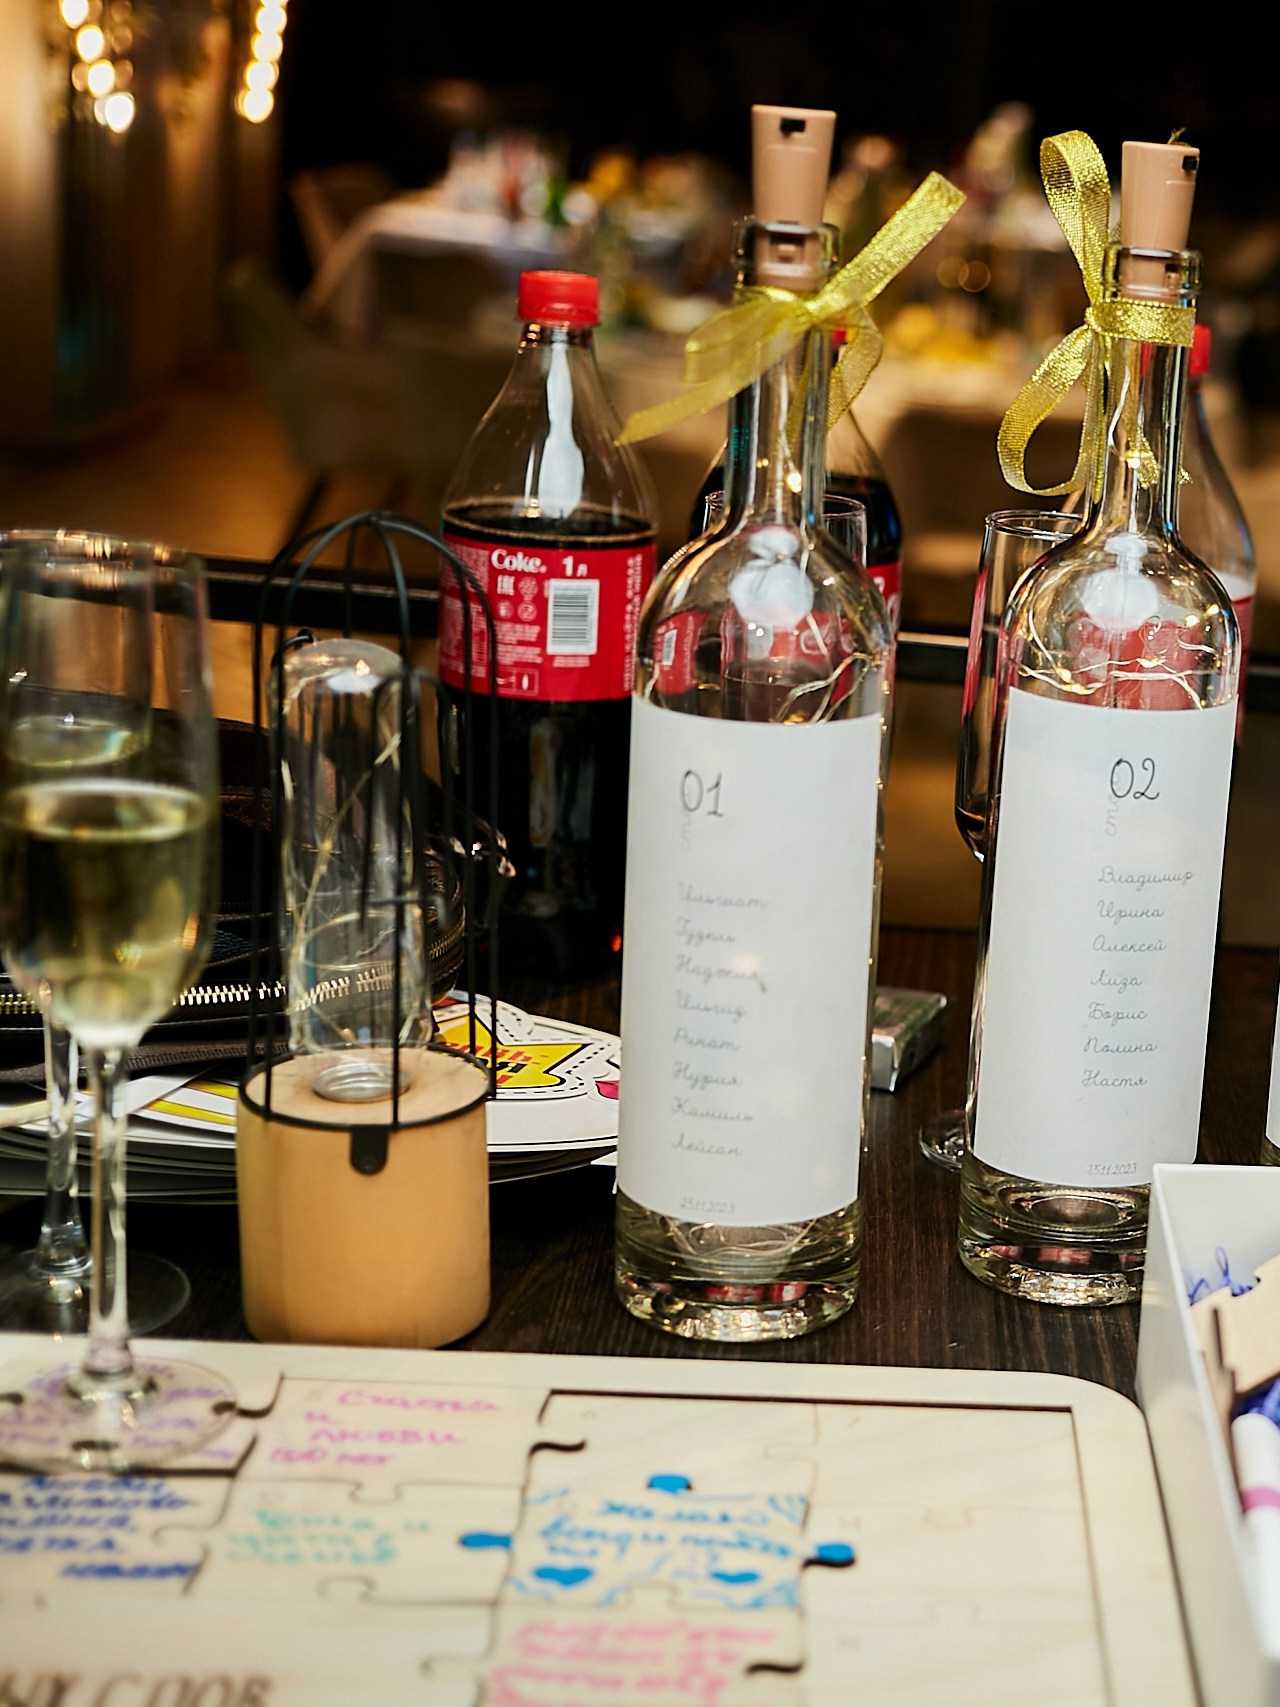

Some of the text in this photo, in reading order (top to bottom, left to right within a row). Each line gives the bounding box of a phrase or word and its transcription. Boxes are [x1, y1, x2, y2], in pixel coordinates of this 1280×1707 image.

[1109, 756, 1161, 802] 02
[679, 768, 725, 819] 01
[1096, 864, 1195, 893] Владимир
[1096, 899, 1166, 927] Ирина
[1091, 933, 1168, 954] Алексей
[1089, 968, 1145, 995] Лиза
[1087, 1001, 1149, 1028] Борис
[1082, 1035, 1159, 1055] Полина
[1080, 1068, 1149, 1088] Настя
